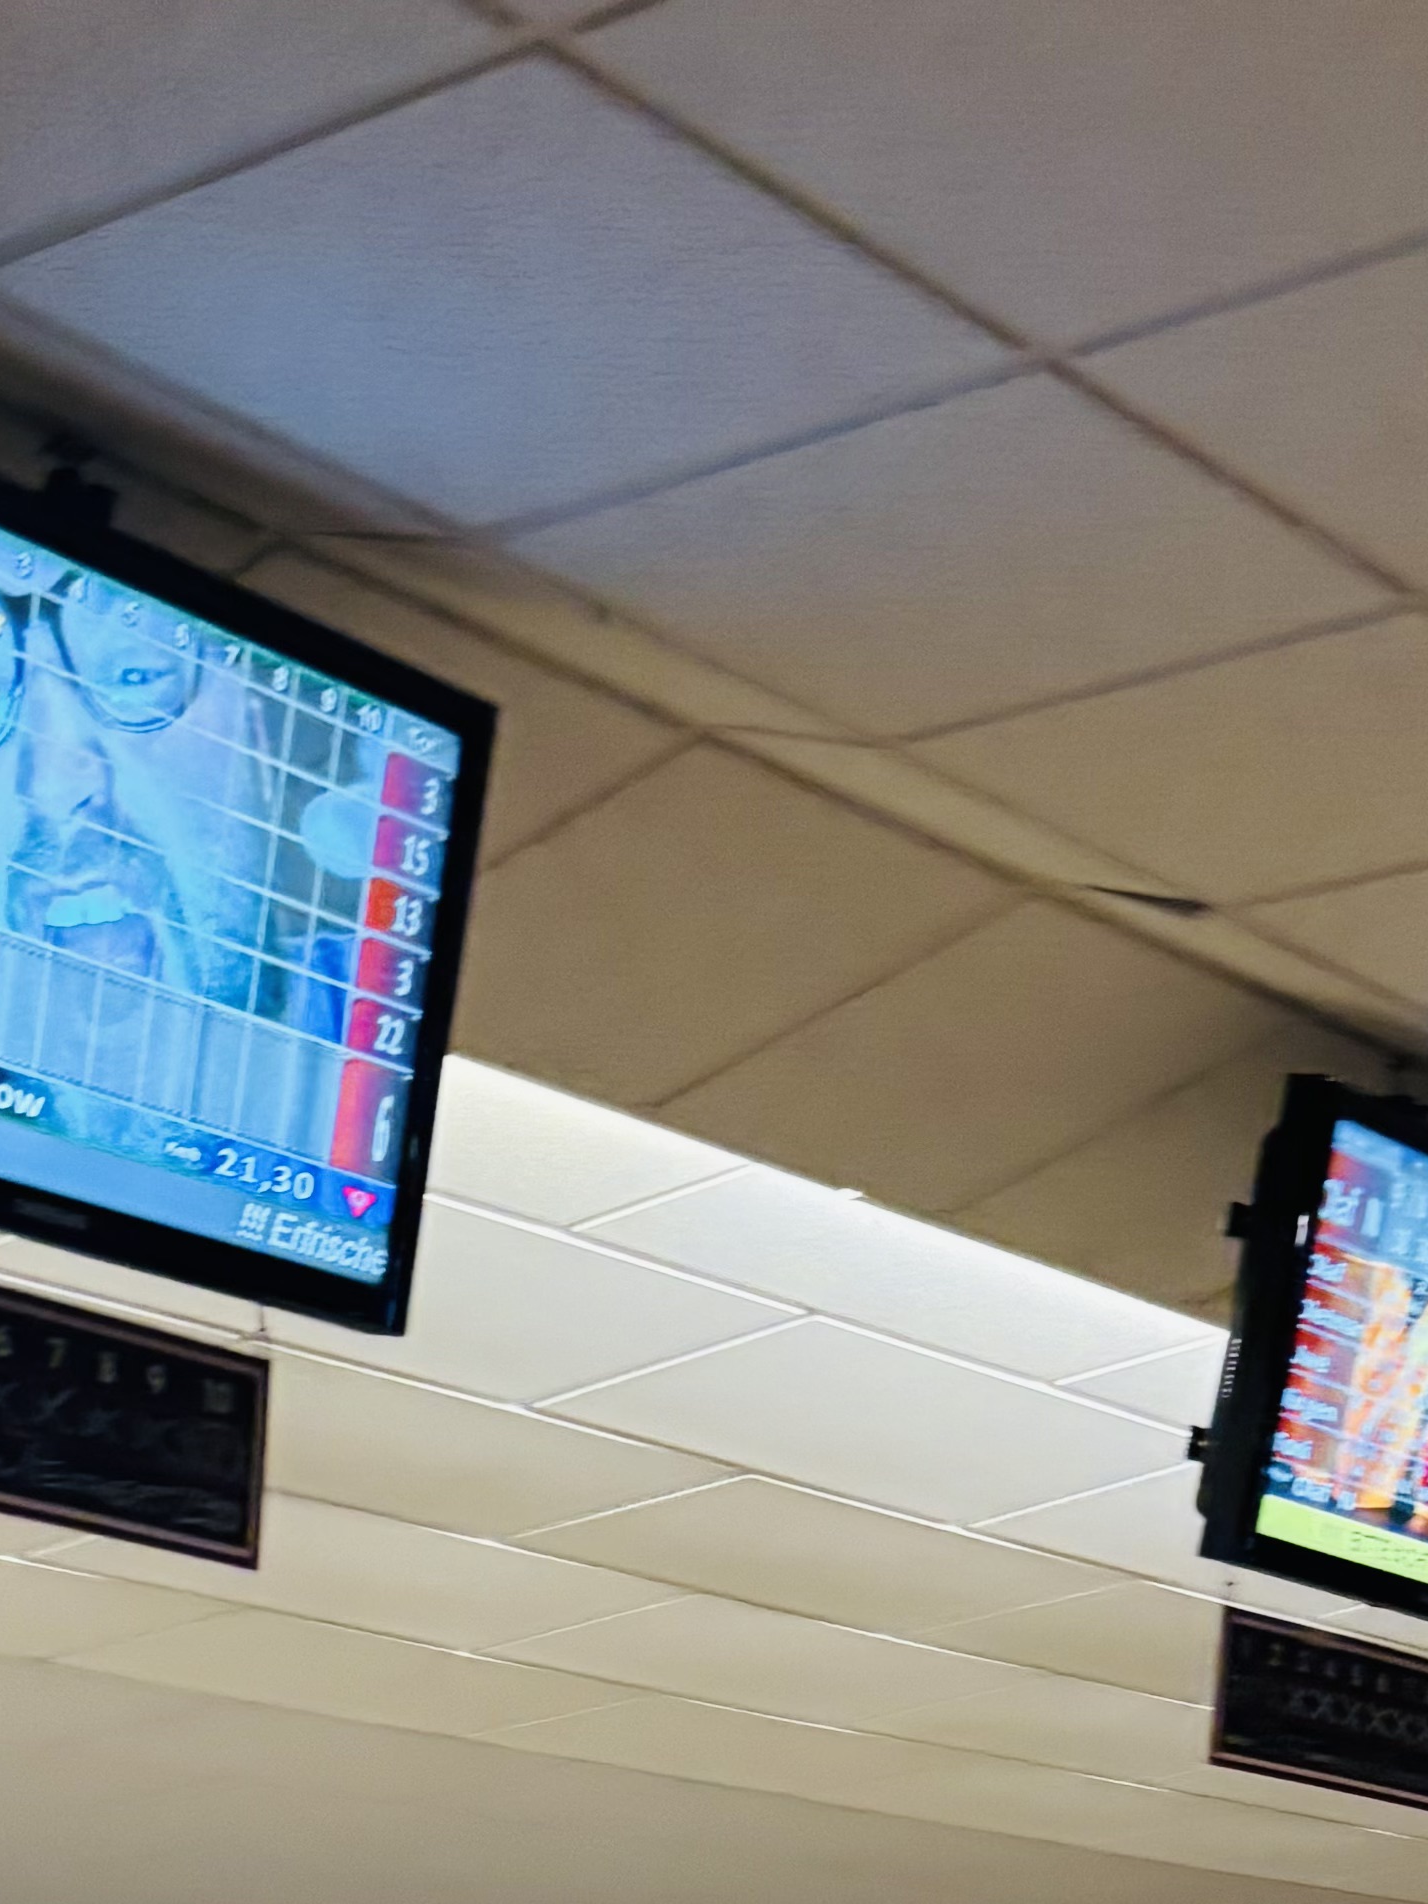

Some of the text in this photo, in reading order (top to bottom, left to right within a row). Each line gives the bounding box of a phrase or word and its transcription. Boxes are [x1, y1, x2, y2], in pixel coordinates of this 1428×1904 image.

[224, 645, 241, 667] 7
[357, 703, 383, 732] 10
[420, 777, 440, 815] 3
[400, 834, 431, 875] 15
[393, 895, 423, 936] 13
[394, 959, 414, 996] 3
[373, 1014, 406, 1056] 22
[371, 1094, 395, 1162] 6
[214, 1147, 316, 1200] 21,30
[268, 1212, 389, 1276] Erfrische
[45, 1336, 68, 1369] 7
